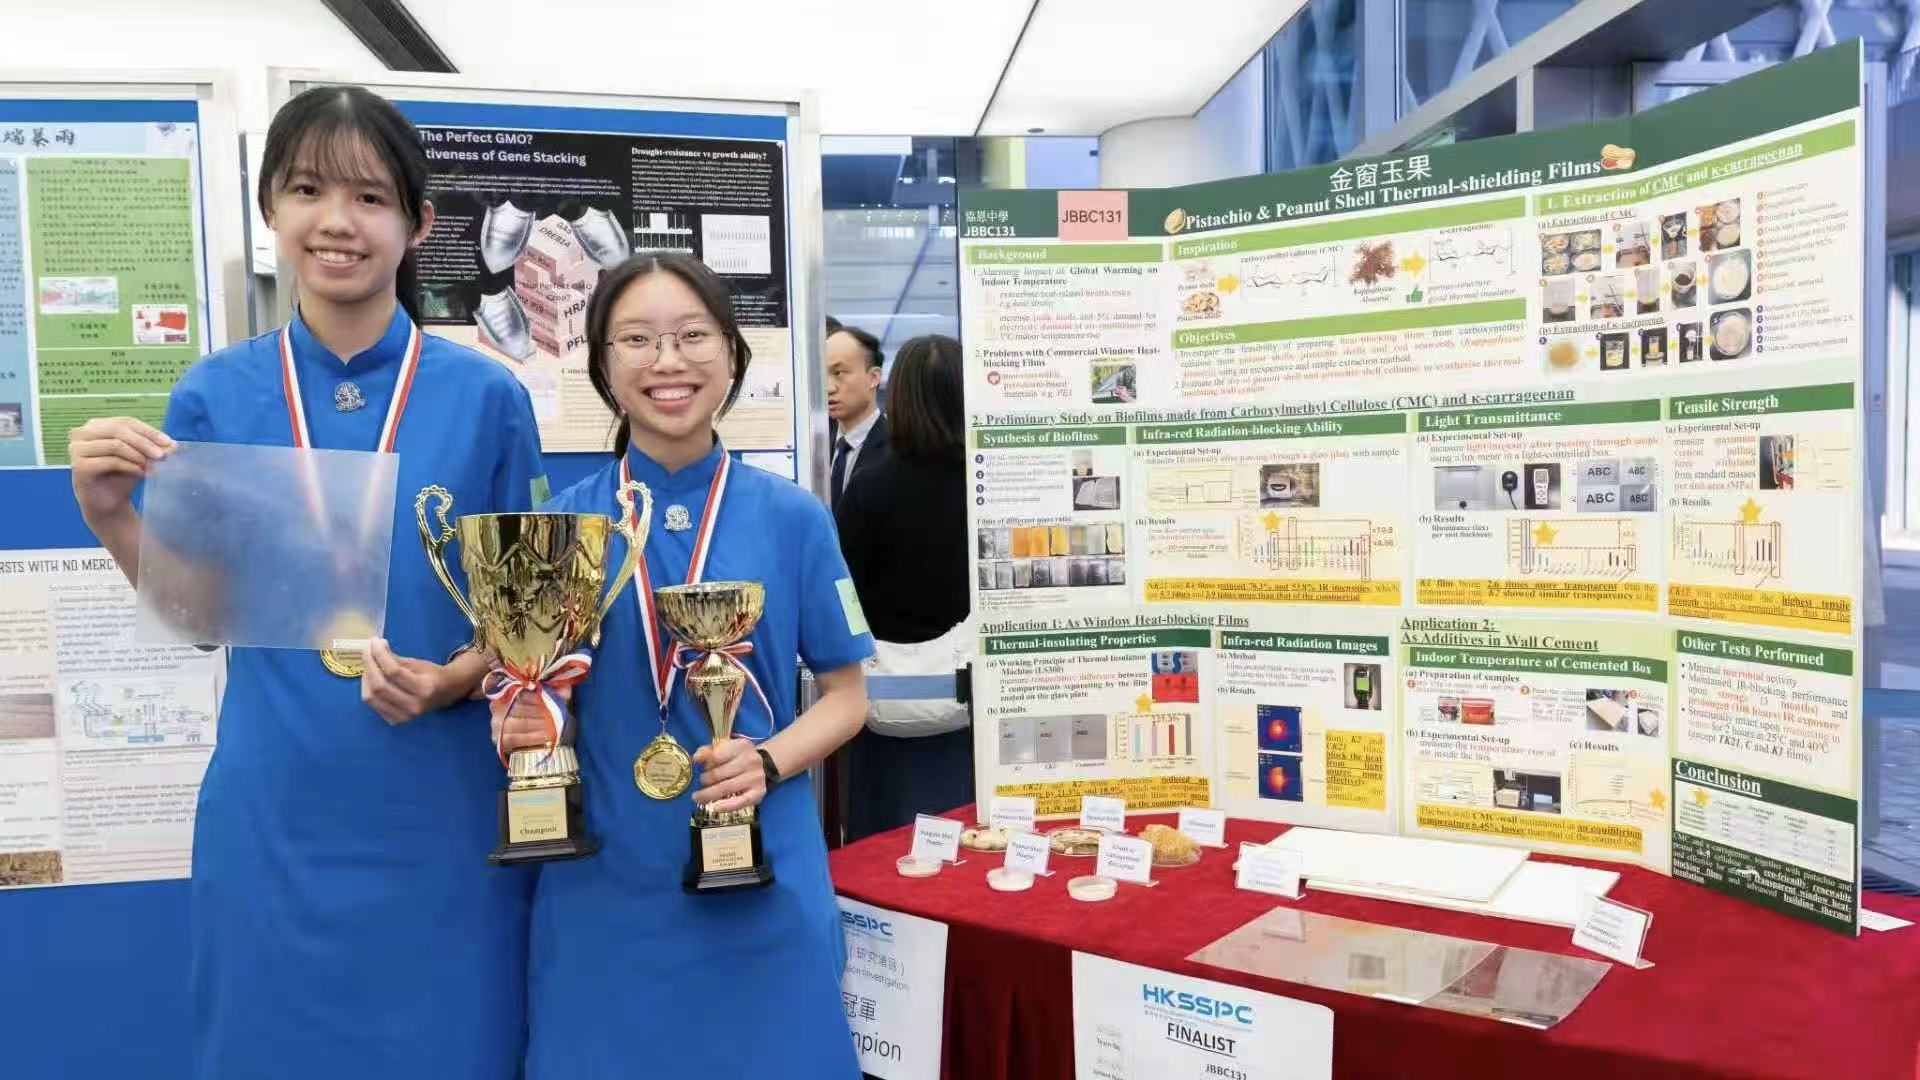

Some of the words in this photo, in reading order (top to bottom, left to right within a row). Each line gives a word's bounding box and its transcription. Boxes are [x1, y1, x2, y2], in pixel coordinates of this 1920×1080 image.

[419, 130, 443, 142] The
[446, 131, 493, 144] Perfect
[496, 134, 533, 145] GMO?
[426, 150, 479, 161] tiveness
[482, 150, 495, 161] of
[498, 151, 530, 164] Gene
[533, 151, 587, 167] Stacking
[632, 147, 701, 157] Drought-resistance
[712, 151, 738, 160] growth
[740, 152, 767, 160] ability?
[1329, 154, 1432, 193] 金窗玉果
[1563, 188, 1636, 206] Extraction
[1639, 182, 1651, 195] of
[1653, 174, 1684, 193] CMC
[1687, 167, 1708, 183] and
[1712, 143, 1803, 178] κ-carrageenan
[1186, 208, 1252, 230] Pistachio
[1256, 206, 1271, 221] &
[1276, 199, 1330, 218] Peanut
[1335, 190, 1376, 209] Shell
[1380, 168, 1543, 203] Thermal-shielding
[1549, 160, 1601, 179] Films
[1062, 210, 1122, 223] JBBC131
[1552, 215, 1600, 228] Extraction
[964, 225, 1016, 237] JBBC131
[978, 248, 1047, 261] Background
[1178, 241, 1239, 256] Inspiration
[1070, 266, 1098, 275] Global
[1103, 266, 1142, 276] Warming
[981, 278, 1010, 287] Indoor
[1013, 277, 1067, 287] Temperature
[1554, 322, 1599, 335] Extraction
[1179, 332, 1236, 344] Objectives
[983, 349, 1024, 359] Problems
[1026, 349, 1044, 358] with
[1046, 347, 1098, 357] Commercial
[1101, 347, 1134, 355] Window
[1137, 346, 1160, 355] Heat-
[983, 359, 1020, 369] blocking
[1022, 358, 1046, 367] Films
[1339, 357, 1378, 367] extraction
[972, 415, 983, 426] 2.
[987, 411, 1056, 426] Preliminary
[1060, 410, 1092, 425] Study
[1097, 414, 1111, 423] on
[1115, 408, 1162, 422] Biofilms
[1167, 408, 1196, 420] made
[1200, 407, 1227, 420] from
[1330, 398, 1388, 414] Cellulose
[1391, 395, 1438, 412] (CMC)
[1442, 393, 1467, 406] and
[1472, 388, 1575, 405] κ-carrageenan
[1675, 400, 1718, 415] Tensile
[1722, 394, 1779, 412] Strength
[1426, 416, 1460, 430] Light
[1465, 411, 1562, 426] Transmittance
[1678, 422, 1731, 433] Experimental
[1734, 421, 1761, 431] Set-up
[983, 433, 1035, 445] Synthesis
[1038, 431, 1049, 442] of
[1053, 430, 1099, 442] Biofilms
[1143, 429, 1193, 441] Infra-red
[1195, 421, 1303, 438] Radiation-blocking
[1304, 421, 1344, 435] Ability
[1431, 432, 1491, 442] Experimental
[1493, 431, 1522, 440] Set-up
[1146, 448, 1195, 458] Experimental
[1197, 446, 1221, 456] Set-up
[1372, 448, 1400, 459] sample
[1477, 453, 1501, 461] meter
[1522, 449, 1590, 460] light-controlled
[1587, 466, 1611, 476] ABC
[1694, 470, 1726, 479] standard
[1586, 492, 1614, 504] ABC
[1629, 493, 1649, 504] ABC
[1682, 498, 1710, 507] Results
[1148, 517, 1176, 526] Results
[1434, 514, 1464, 523] Results
[28, 560, 58, 572] WITH
[60, 560, 78, 571] NO
[1564, 582, 1617, 592] transparent
[1539, 590, 1570, 598] similar
[1573, 591, 1633, 601] transparency
[980, 619, 1048, 634] Application
[1051, 618, 1062, 629] 1:
[1067, 618, 1080, 628] As
[1084, 616, 1131, 628] Window
[1135, 615, 1214, 629] Heat-blocking
[1217, 616, 1249, 627] Films
[1401, 617, 1478, 631] Application
[1482, 620, 1496, 631] 2:
[991, 637, 1097, 650] Thermal-insulating
[1100, 634, 1157, 648] Properties
[1224, 636, 1273, 647] Infra-red
[1277, 637, 1332, 649] Radiation
[1336, 640, 1377, 652] Images
[1401, 633, 1418, 644] As
[1423, 633, 1484, 646] Additives
[1489, 635, 1501, 646] in
[1506, 636, 1538, 648] Wall
[1543, 636, 1598, 650] Cement
[1229, 652, 1256, 660] Method
[1682, 636, 1717, 652] Other
[1720, 640, 1750, 657] Tests
[1755, 645, 1824, 667] Performed
[999, 659, 1031, 668] Working
[1033, 657, 1067, 666] Principle
[1078, 656, 1109, 664] Thermal
[1111, 654, 1147, 662] Insulation
[1416, 652, 1456, 664] Indoor
[1461, 654, 1541, 669] Temperature
[1545, 656, 1558, 668] of
[1562, 657, 1628, 672] Cemented
[1632, 662, 1652, 674] Box
[1420, 670, 1471, 681] Preparation
[1484, 674, 1520, 683] samples
[1766, 673, 1797, 688] activity
[1008, 684, 1061, 693] compartments
[1230, 687, 1256, 695] Results
[1688, 673, 1732, 689] Maintained
[1737, 679, 1786, 698] IR-blocking
[1792, 691, 1848, 707] performance
[1000, 706, 1026, 714] Results
[1688, 707, 1732, 723] Structurally
[1420, 730, 1479, 742] Experimental
[1480, 734, 1510, 745] Set-up
[1585, 741, 1619, 751] Results
[1786, 748, 1812, 763] films)
[1675, 760, 1762, 795] Conclusion
[1420, 817, 1475, 830] temperature
[520, 825, 557, 836] Champion
[1591, 825, 1642, 839] equilibrium
[1142, 983, 1254, 1025] HKSSPC
[1167, 1022, 1236, 1054] FINALIST
[1205, 1063, 1248, 1080] JBBC131
